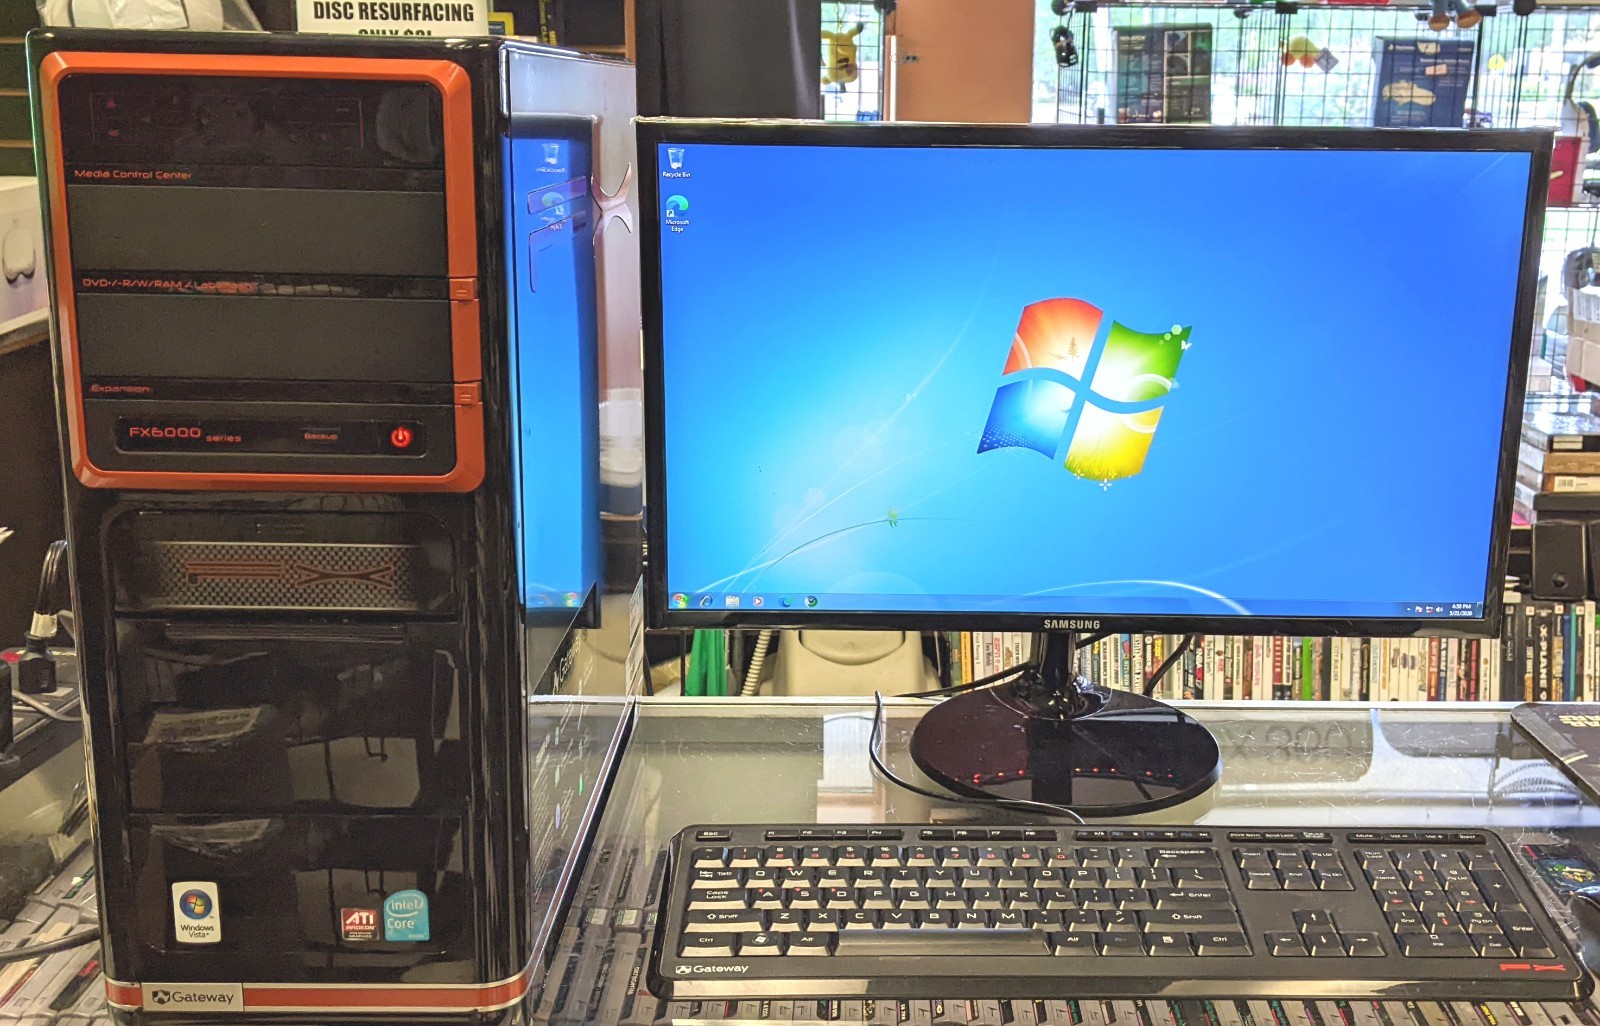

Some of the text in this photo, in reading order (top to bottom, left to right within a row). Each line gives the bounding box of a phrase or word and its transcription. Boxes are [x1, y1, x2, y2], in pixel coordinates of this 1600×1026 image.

[313, 1, 474, 22] DISC RESURFACING
[74, 169, 192, 180] Media Control Center
[91, 384, 153, 393] Expansion
[129, 427, 242, 442] FX6000 series
[1043, 619, 1100, 629] SAMSUNG
[1539, 626, 1548, 688] X-PLANE
[391, 899, 418, 910] intel
[345, 911, 374, 925] ATI
[387, 918, 414, 929] Core
[180, 924, 215, 932] Windows
[693, 965, 749, 974] Gateway
[172, 991, 234, 1005] Gateway
